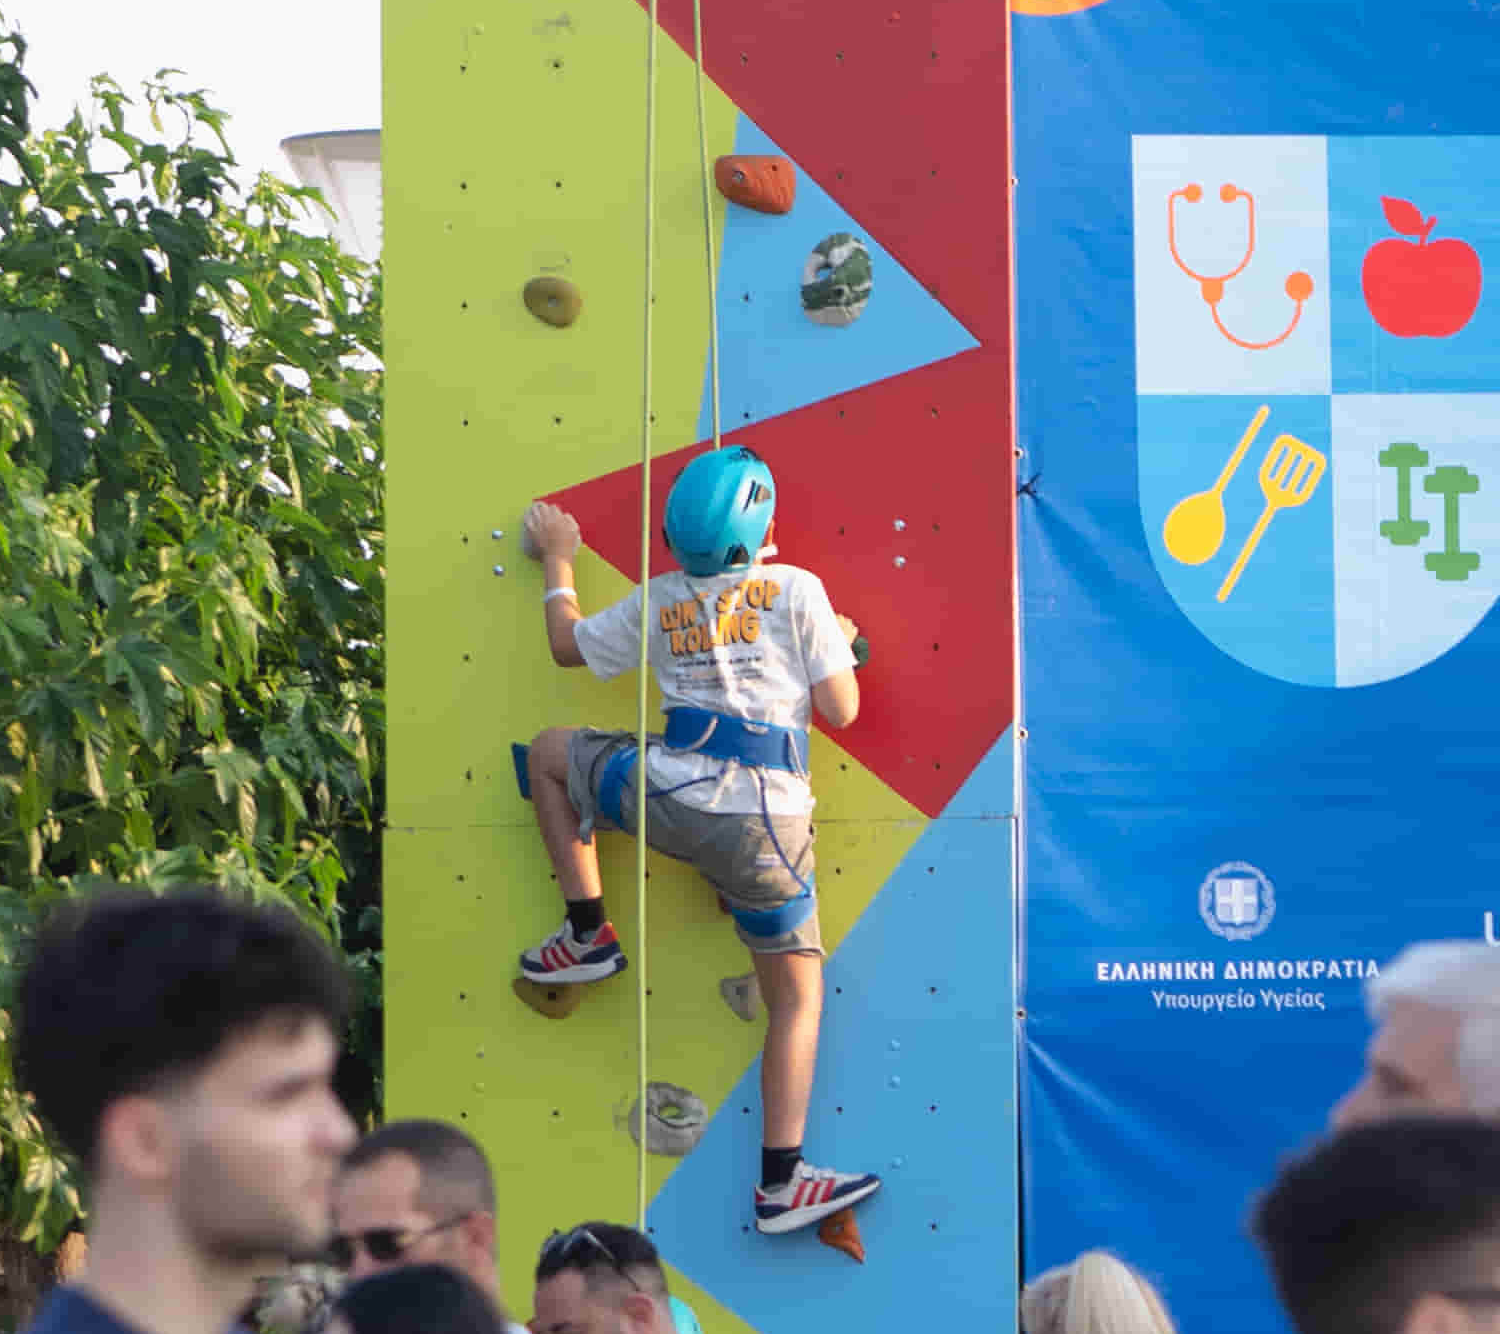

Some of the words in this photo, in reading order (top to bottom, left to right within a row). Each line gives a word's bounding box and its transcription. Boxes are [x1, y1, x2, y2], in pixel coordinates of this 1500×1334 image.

[1096, 961, 1215, 982] ΕΛΛΗΝΙΚΗ
[1223, 959, 1381, 981] ΔΗΜΟΚΡΑΤΙΑ
[1151, 987, 1256, 1012] Υπουργείο
[1258, 986, 1326, 1012] Υγείας
